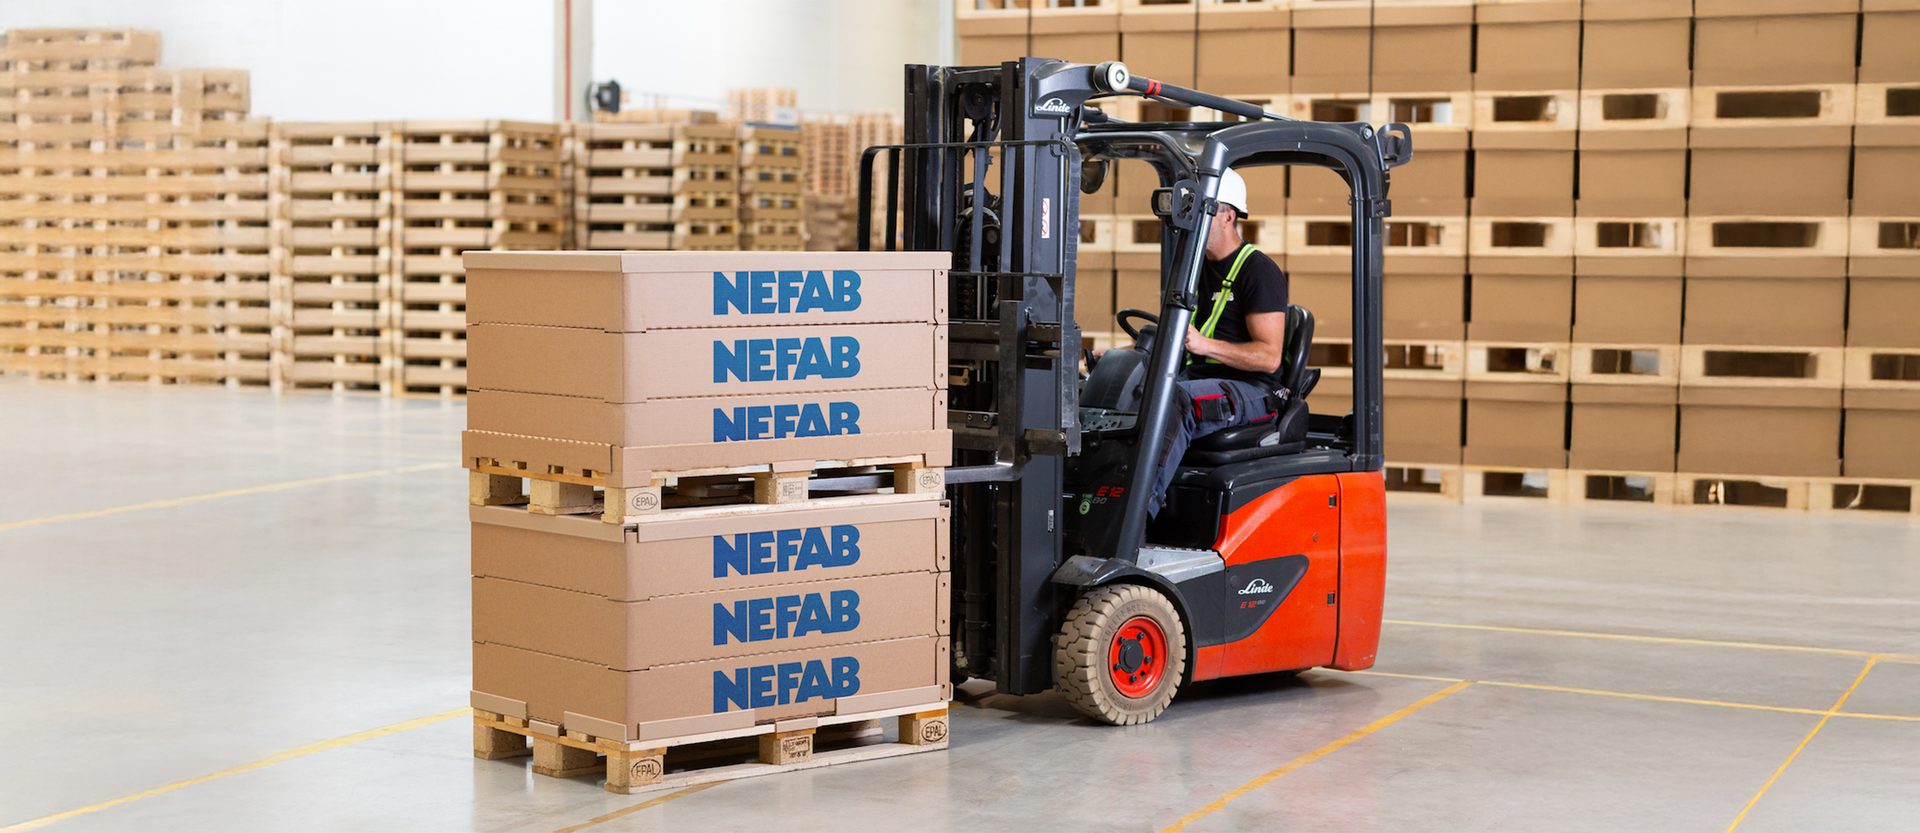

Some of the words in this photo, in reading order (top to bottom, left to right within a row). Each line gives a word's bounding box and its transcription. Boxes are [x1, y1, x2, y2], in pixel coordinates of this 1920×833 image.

[1035, 97, 1071, 113] Linde
[713, 269, 862, 316] NEFAB
[713, 335, 861, 384] NEFAB
[713, 401, 861, 443] NEFAB
[636, 496, 656, 507] EPAL
[1096, 485, 1110, 497] E
[1109, 487, 1125, 498] 12
[713, 524, 861, 578] NEFAB
[1238, 578, 1274, 595] Linde
[713, 589, 861, 646] NEFAB
[713, 656, 861, 713] NEFAB
[925, 725, 942, 738] EPAL
[636, 763, 657, 777] EPAL
